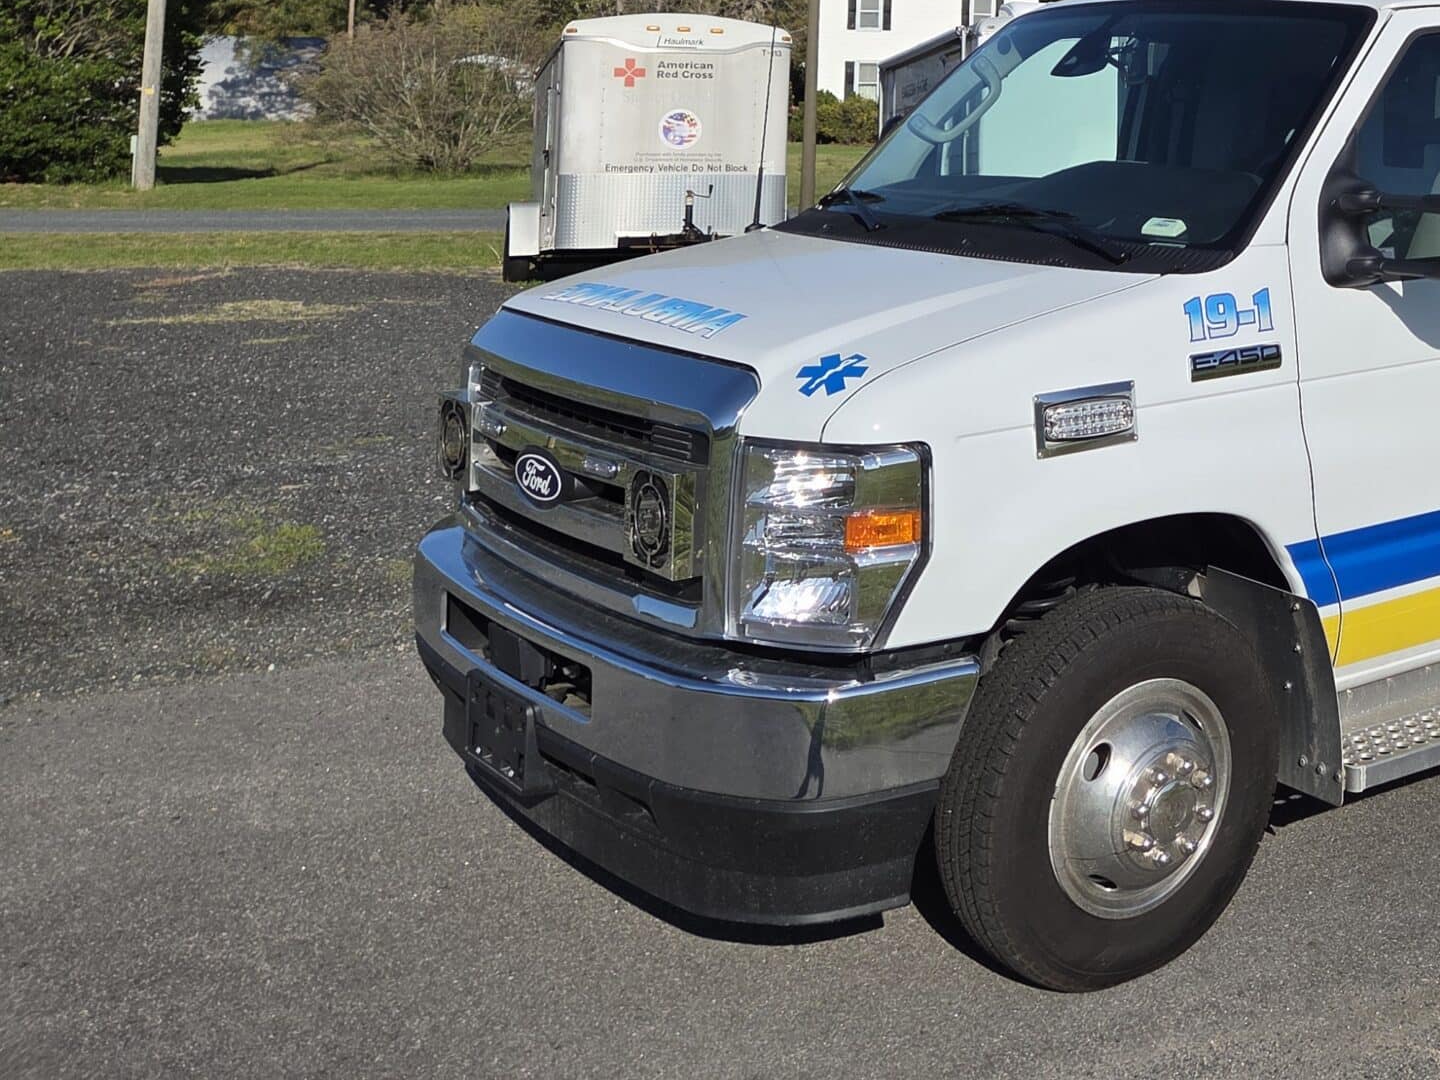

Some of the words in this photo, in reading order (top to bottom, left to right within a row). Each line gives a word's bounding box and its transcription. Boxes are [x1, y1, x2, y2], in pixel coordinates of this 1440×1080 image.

[657, 60, 714, 70] American
[656, 70, 678, 79] Red
[681, 70, 714, 79] Cross
[605, 163, 654, 174] Emergency
[658, 163, 688, 173] Vehicle
[692, 163, 704, 173] Do
[707, 163, 722, 173] Not
[725, 163, 748, 173] Block
[1183, 287, 1274, 342] 19-1
[521, 458, 552, 496] Ford
